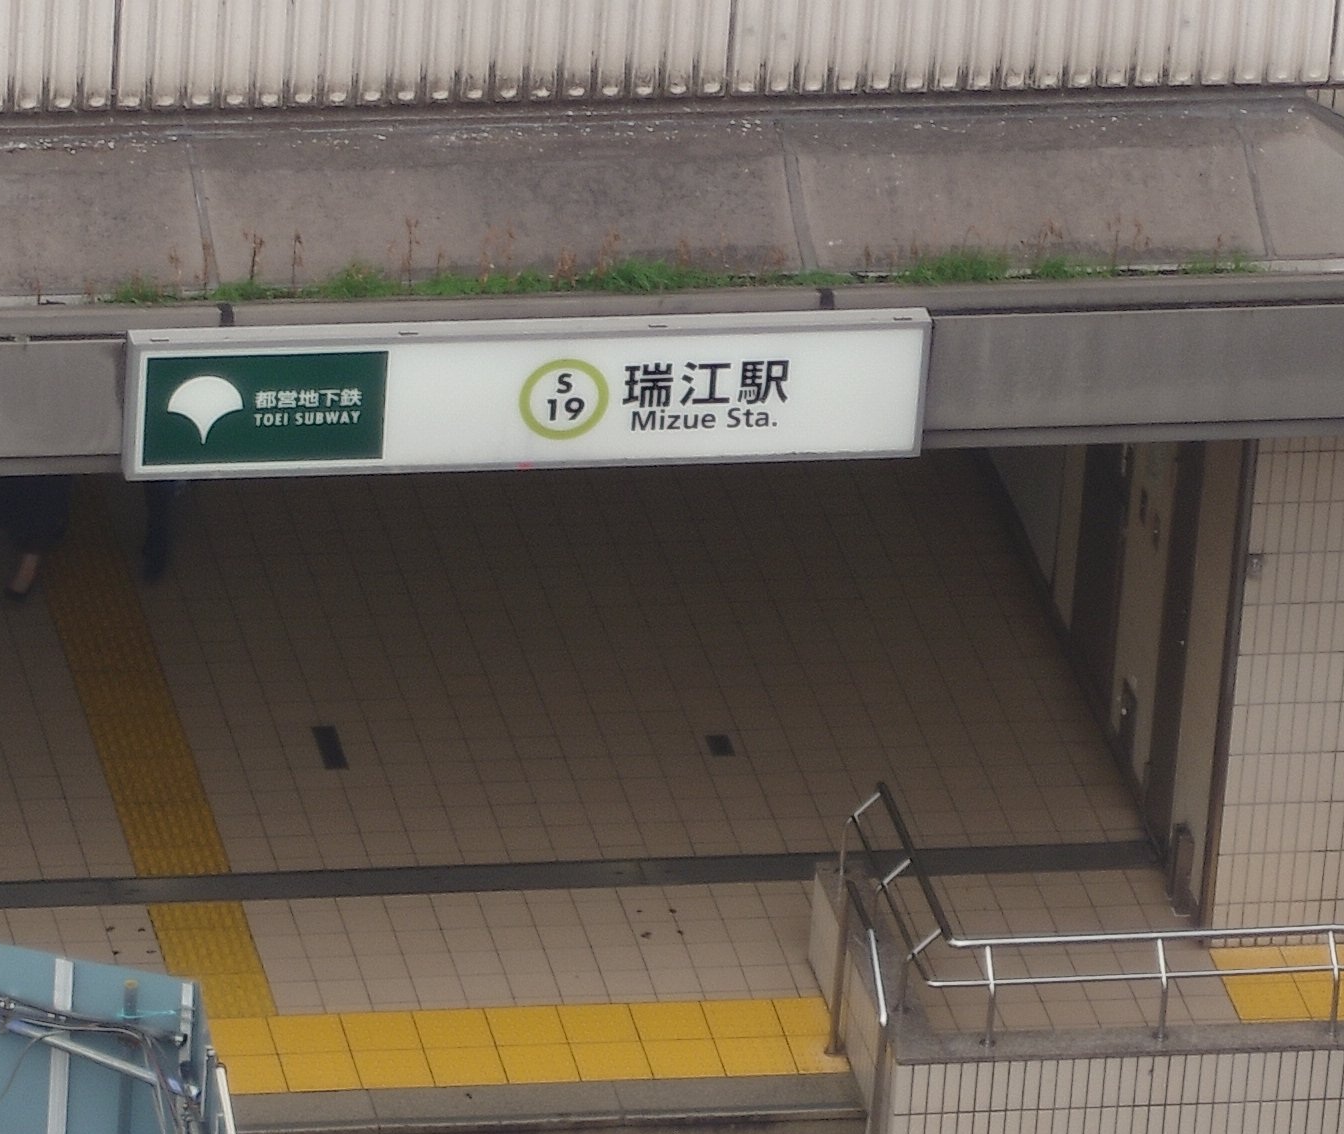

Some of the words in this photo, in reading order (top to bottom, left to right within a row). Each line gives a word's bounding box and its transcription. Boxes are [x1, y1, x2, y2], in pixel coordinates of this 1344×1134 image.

[556, 372, 573, 394] S
[622, 359, 790, 408] 瑞江駅
[254, 388, 363, 409] 都営地下鉄
[547, 396, 585, 421] 19
[254, 412, 289, 427] TOEI
[295, 411, 361, 426] SUBWAY
[631, 409, 716, 431] Mizue
[727, 407, 778, 429] Sta.
